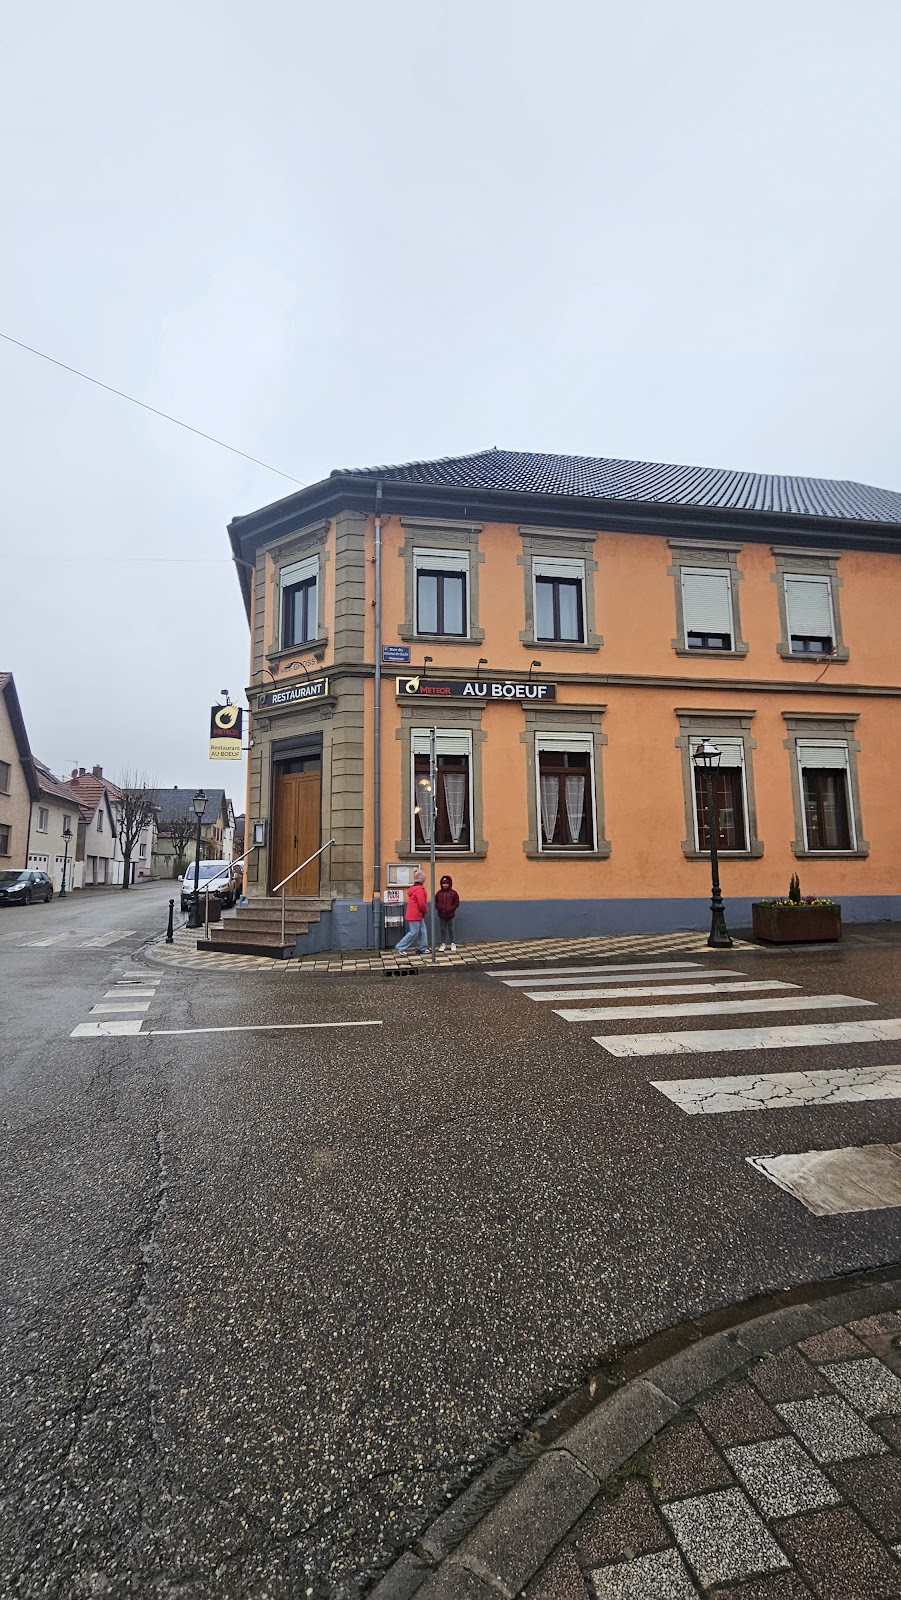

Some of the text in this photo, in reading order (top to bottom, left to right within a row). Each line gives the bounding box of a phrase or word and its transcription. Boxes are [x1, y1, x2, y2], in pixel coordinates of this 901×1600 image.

[272, 684, 323, 704] RESTAURANT
[420, 686, 451, 695] METEOR
[462, 683, 548, 698] AU BOEUF
